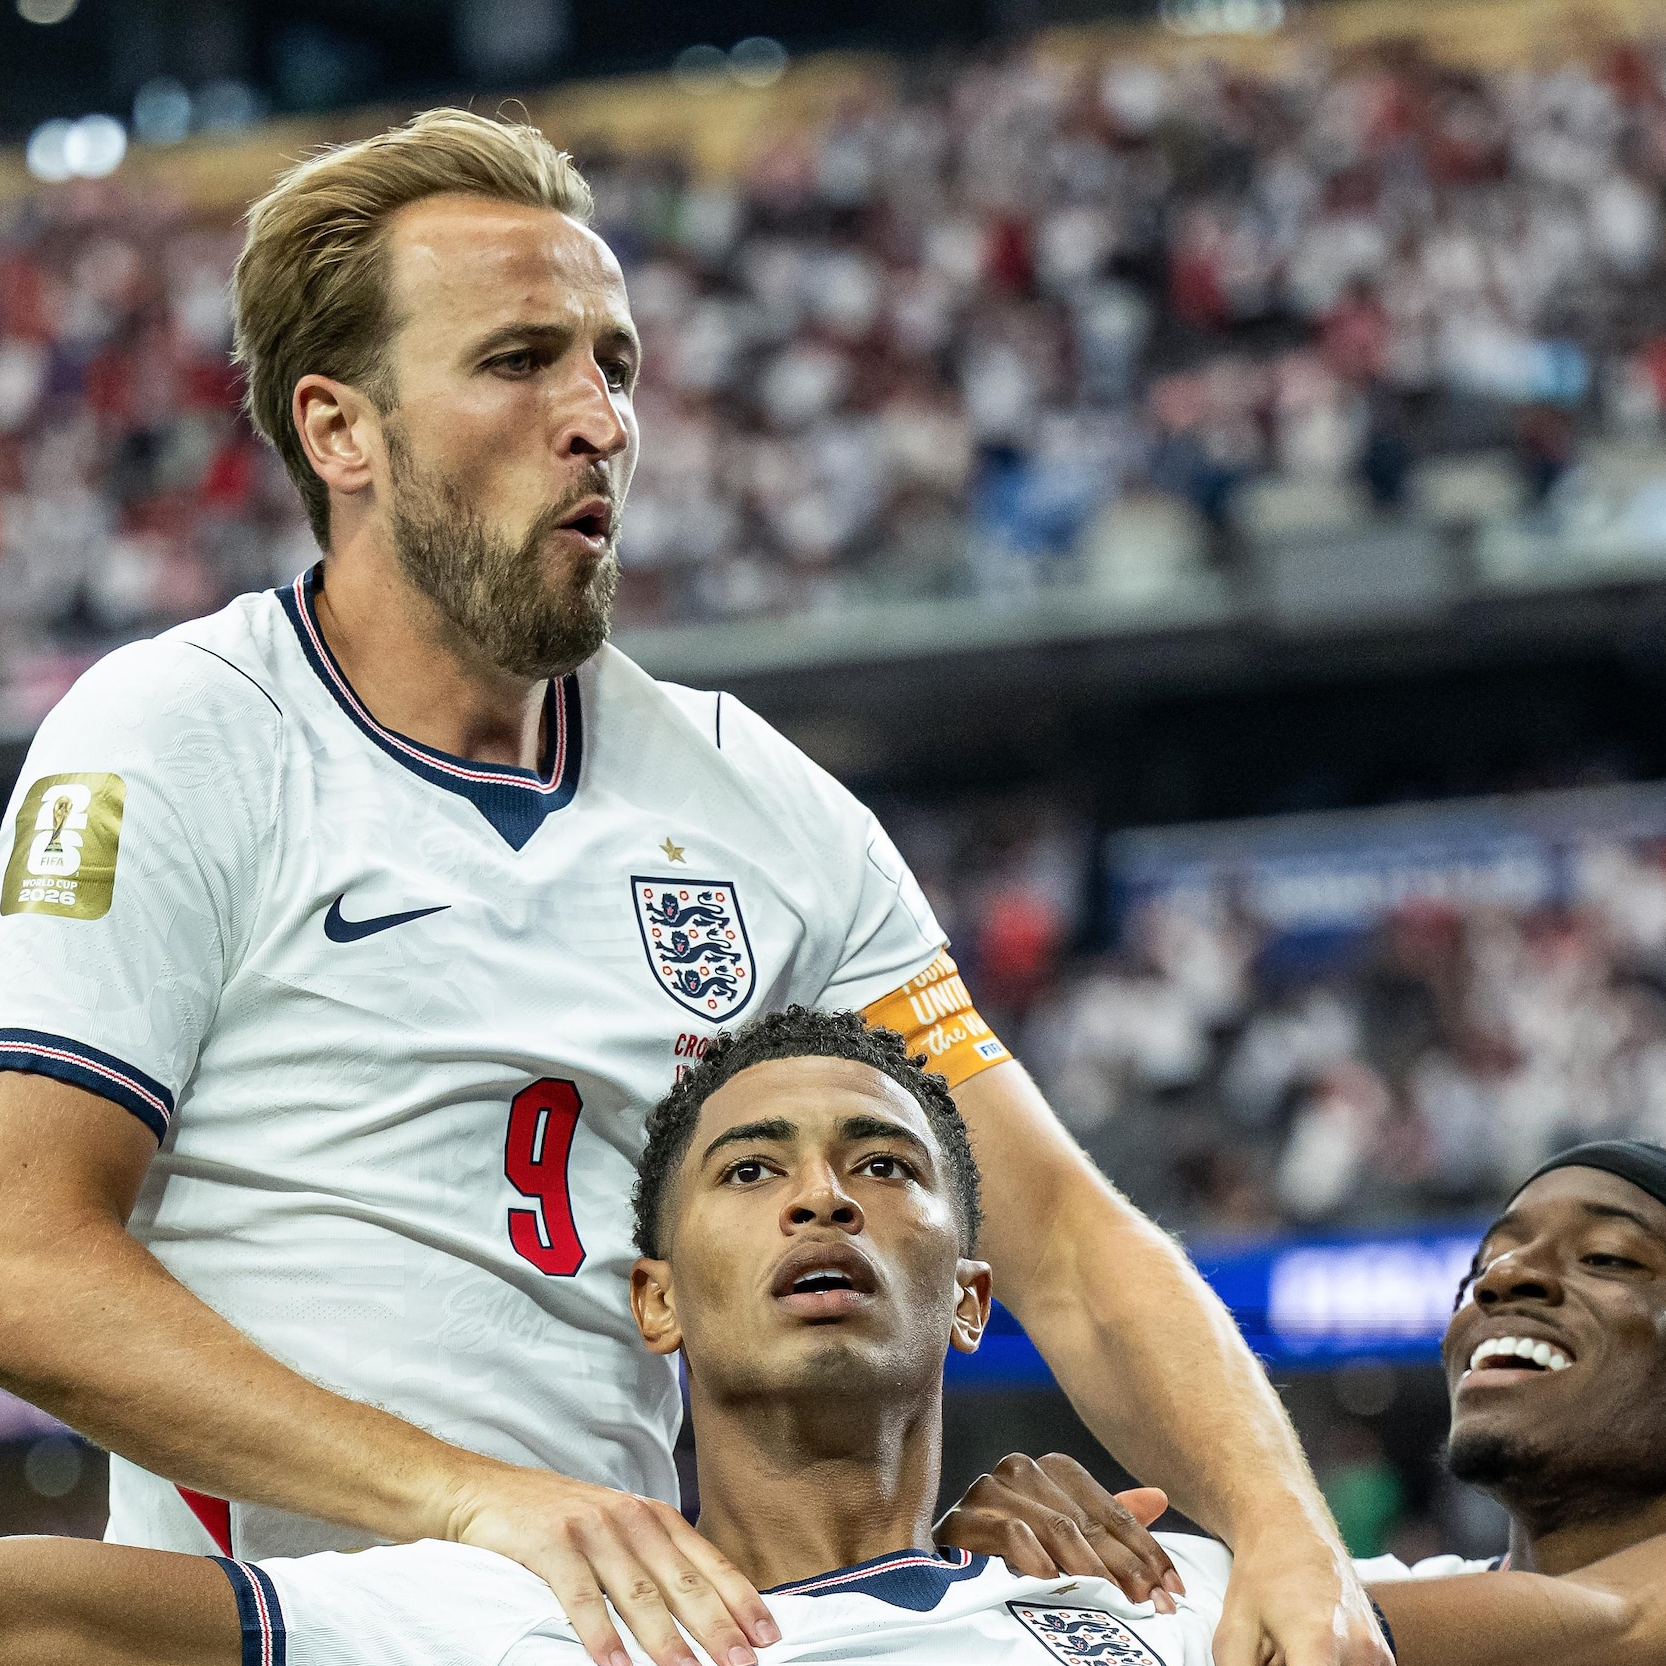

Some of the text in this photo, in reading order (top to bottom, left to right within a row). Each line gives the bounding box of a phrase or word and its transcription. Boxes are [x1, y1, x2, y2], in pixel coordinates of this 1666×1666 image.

[40, 856, 64, 867] FIFA
[22, 878, 77, 889] WORLD CUP
[18, 888, 75, 905] 2026
[674, 1032, 720, 1059] CRO
[920, 1024, 967, 1056] the
[504, 1076, 587, 1278] 9
